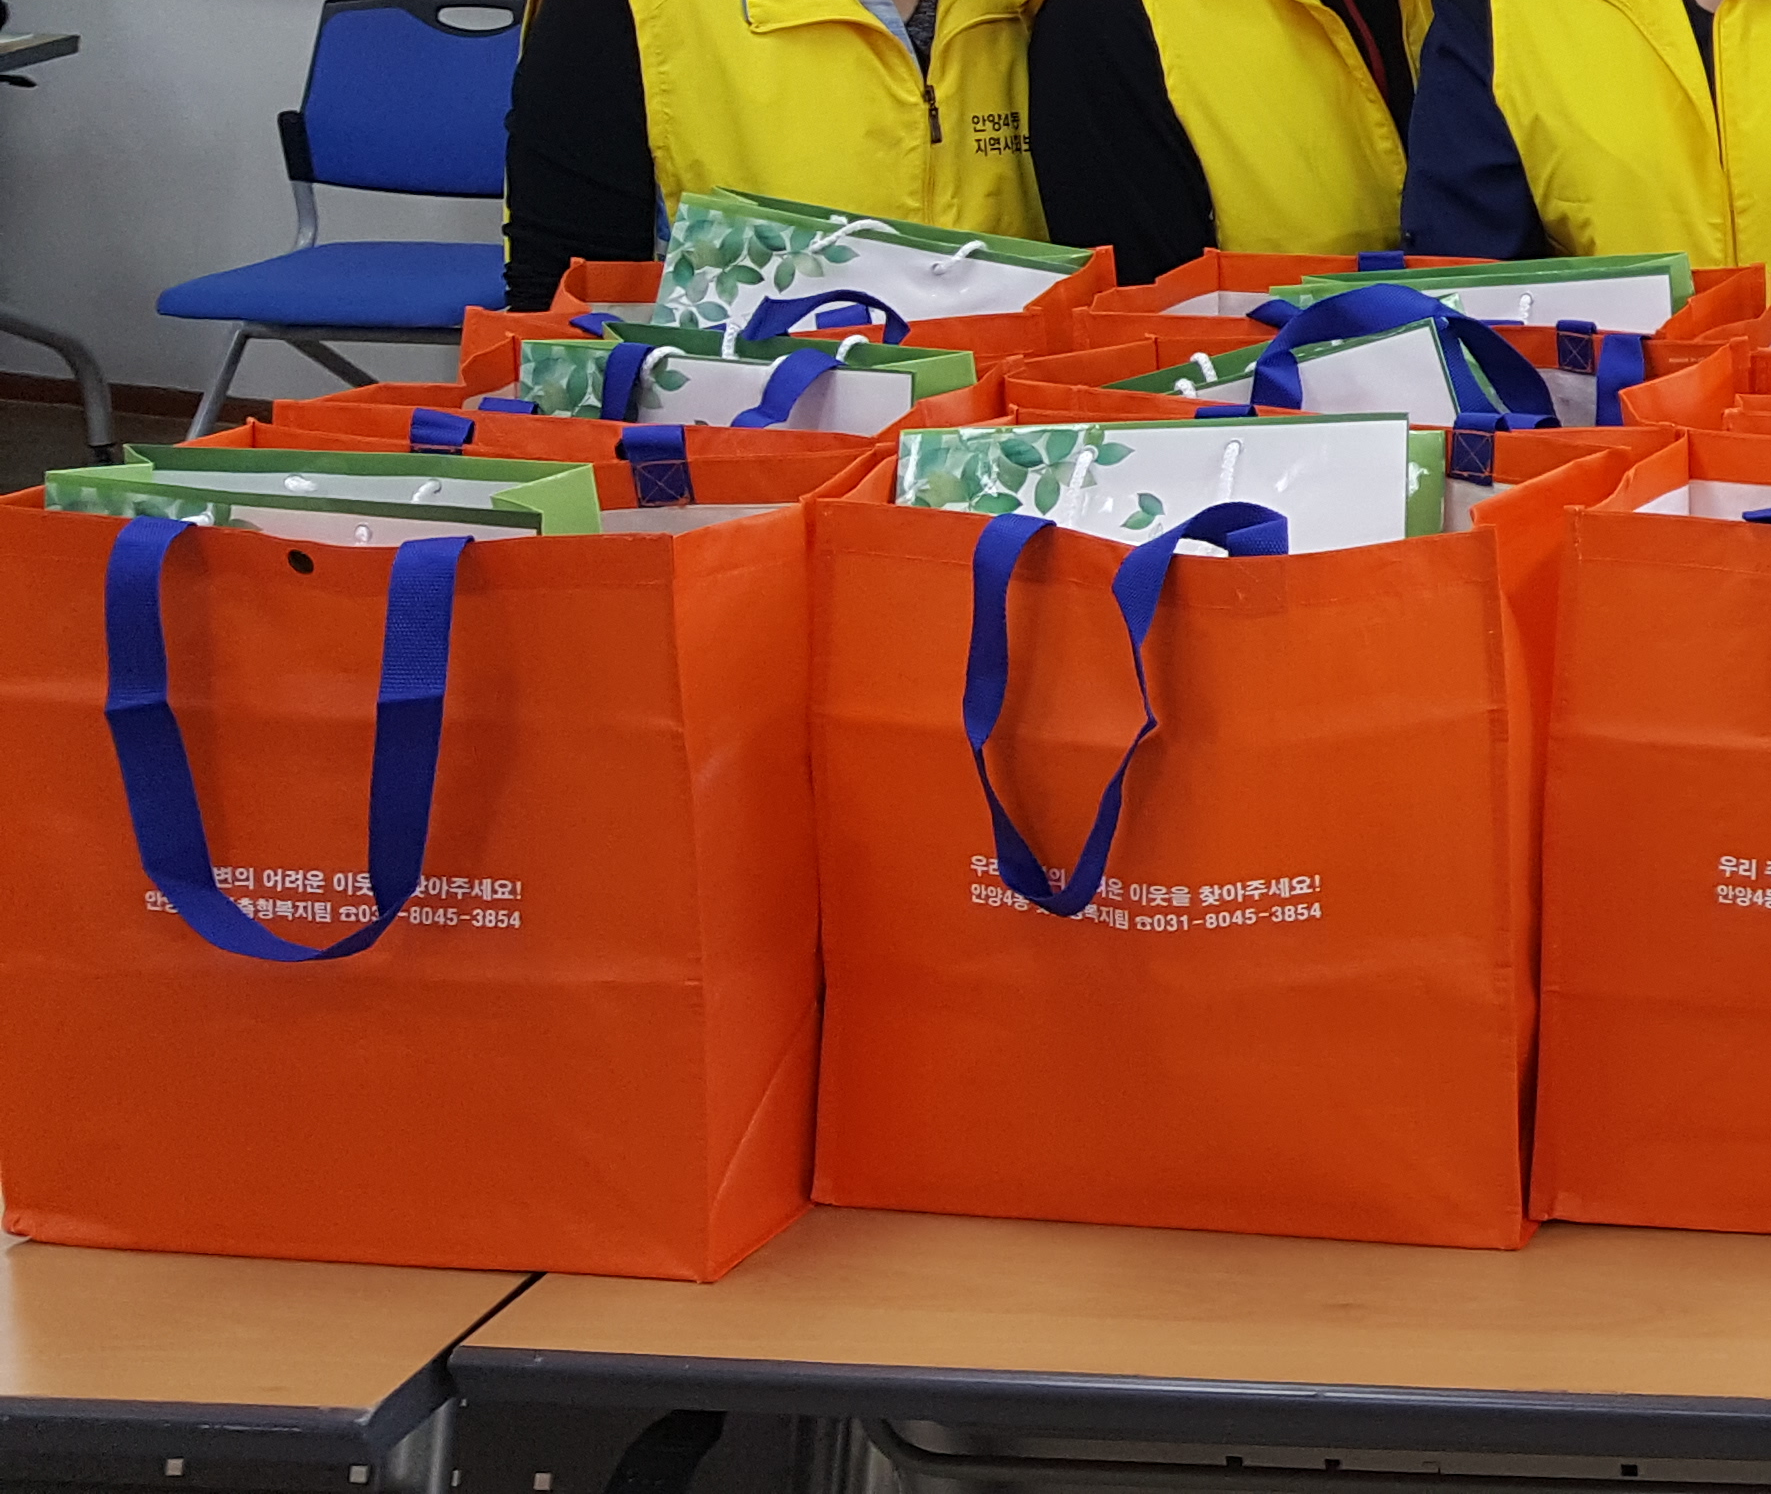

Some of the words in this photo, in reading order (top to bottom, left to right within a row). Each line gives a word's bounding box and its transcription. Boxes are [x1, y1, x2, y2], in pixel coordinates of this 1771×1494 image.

[971, 112, 1021, 134] 안양4동
[974, 135, 1032, 157] 지역사회보
[1718, 855, 1757, 880] 우리
[212, 866, 255, 890] 변의
[263, 868, 325, 894] 어려운
[333, 872, 374, 896] 이웃
[1130, 884, 1191, 907] 이웃을
[1200, 874, 1322, 907] 찾아주세요!
[357, 904, 522, 929] 03-8045-3854
[970, 883, 1030, 912] 안양4동
[1153, 902, 1322, 932] 031-8045-3854
